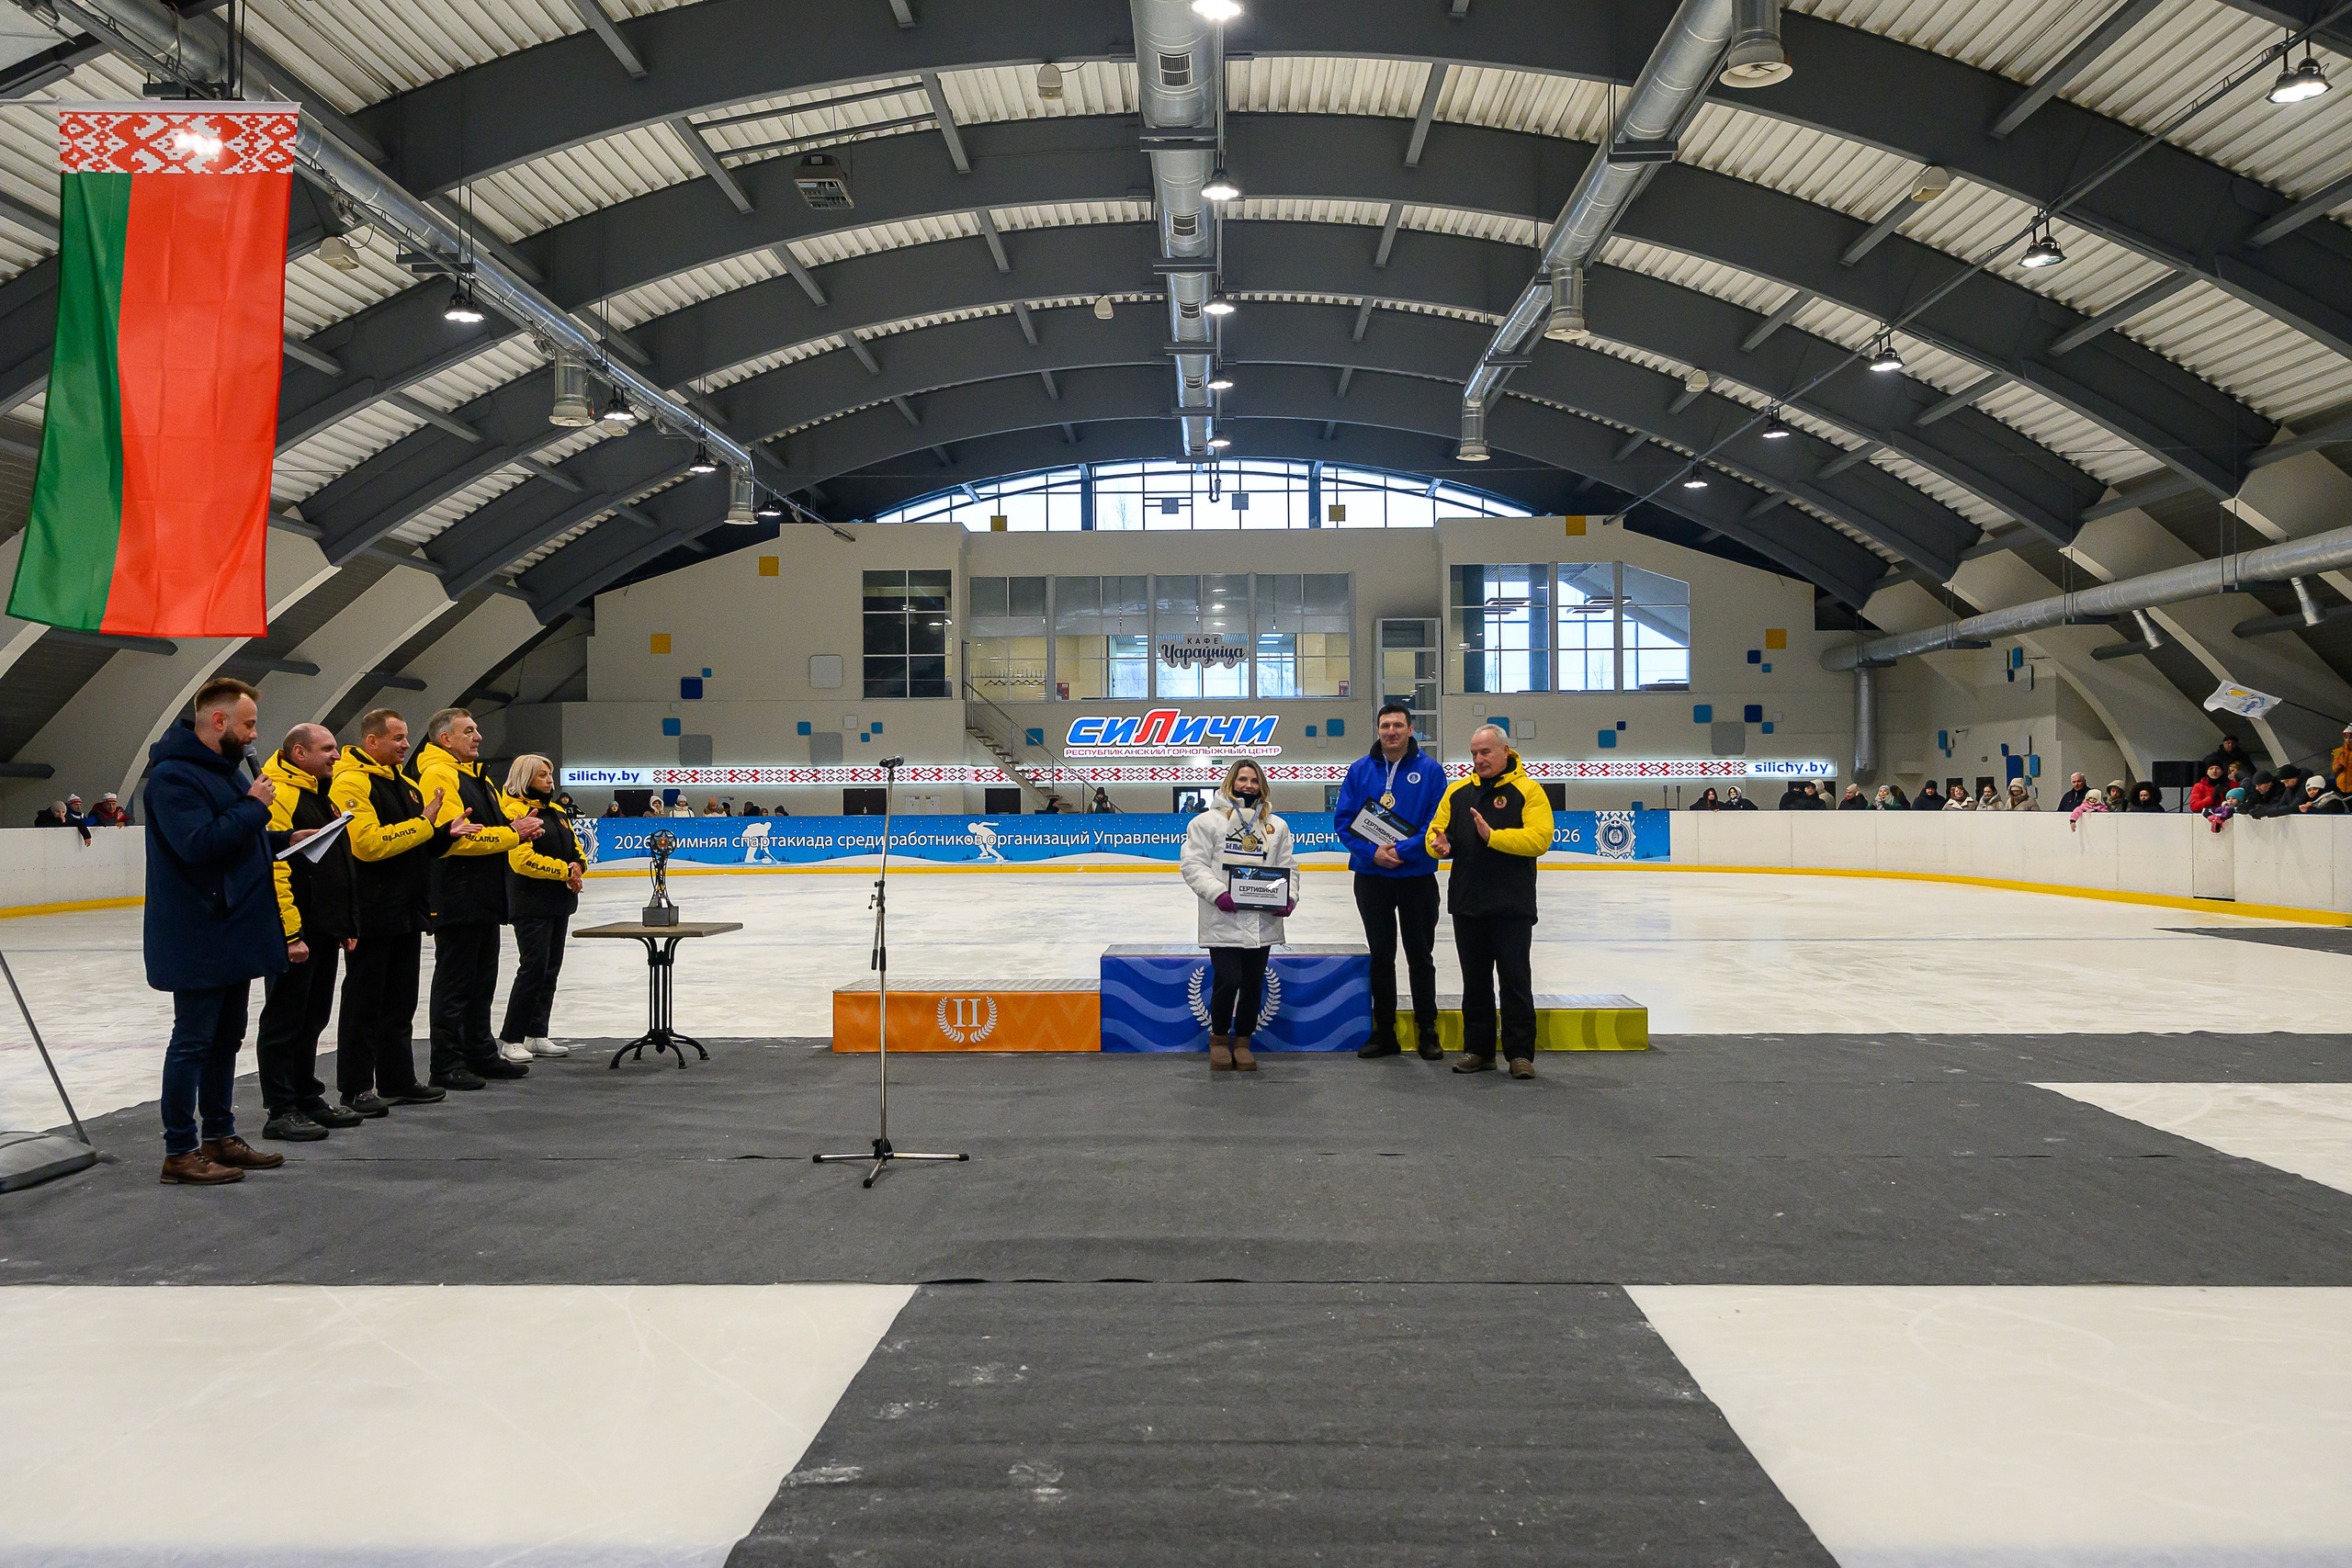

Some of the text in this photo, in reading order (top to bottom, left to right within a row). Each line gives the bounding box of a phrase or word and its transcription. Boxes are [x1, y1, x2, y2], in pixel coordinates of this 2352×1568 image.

[1187, 637, 1218, 645] КАФЕ
[1066, 747, 1280, 756] РЕСПУБЛИКАНСКИЙ ГОРНОЛЫЖНЫЙ ЦЕНТР
[1755, 761, 1829, 774] silichy.by
[568, 770, 640, 784] silichy.by
[614, 835, 651, 851] 2026
[669, 836, 728, 850] имняя
[731, 835, 833, 852] спартакиада
[837, 834, 885, 851] среди
[889, 829, 983, 850] работников
[986, 829, 1091, 850] организаций
[1093, 829, 1189, 849] Управления
[1553, 829, 1580, 843] 026
[525, 860, 562, 875] BELARUS
[952, 998, 982, 1028] II
